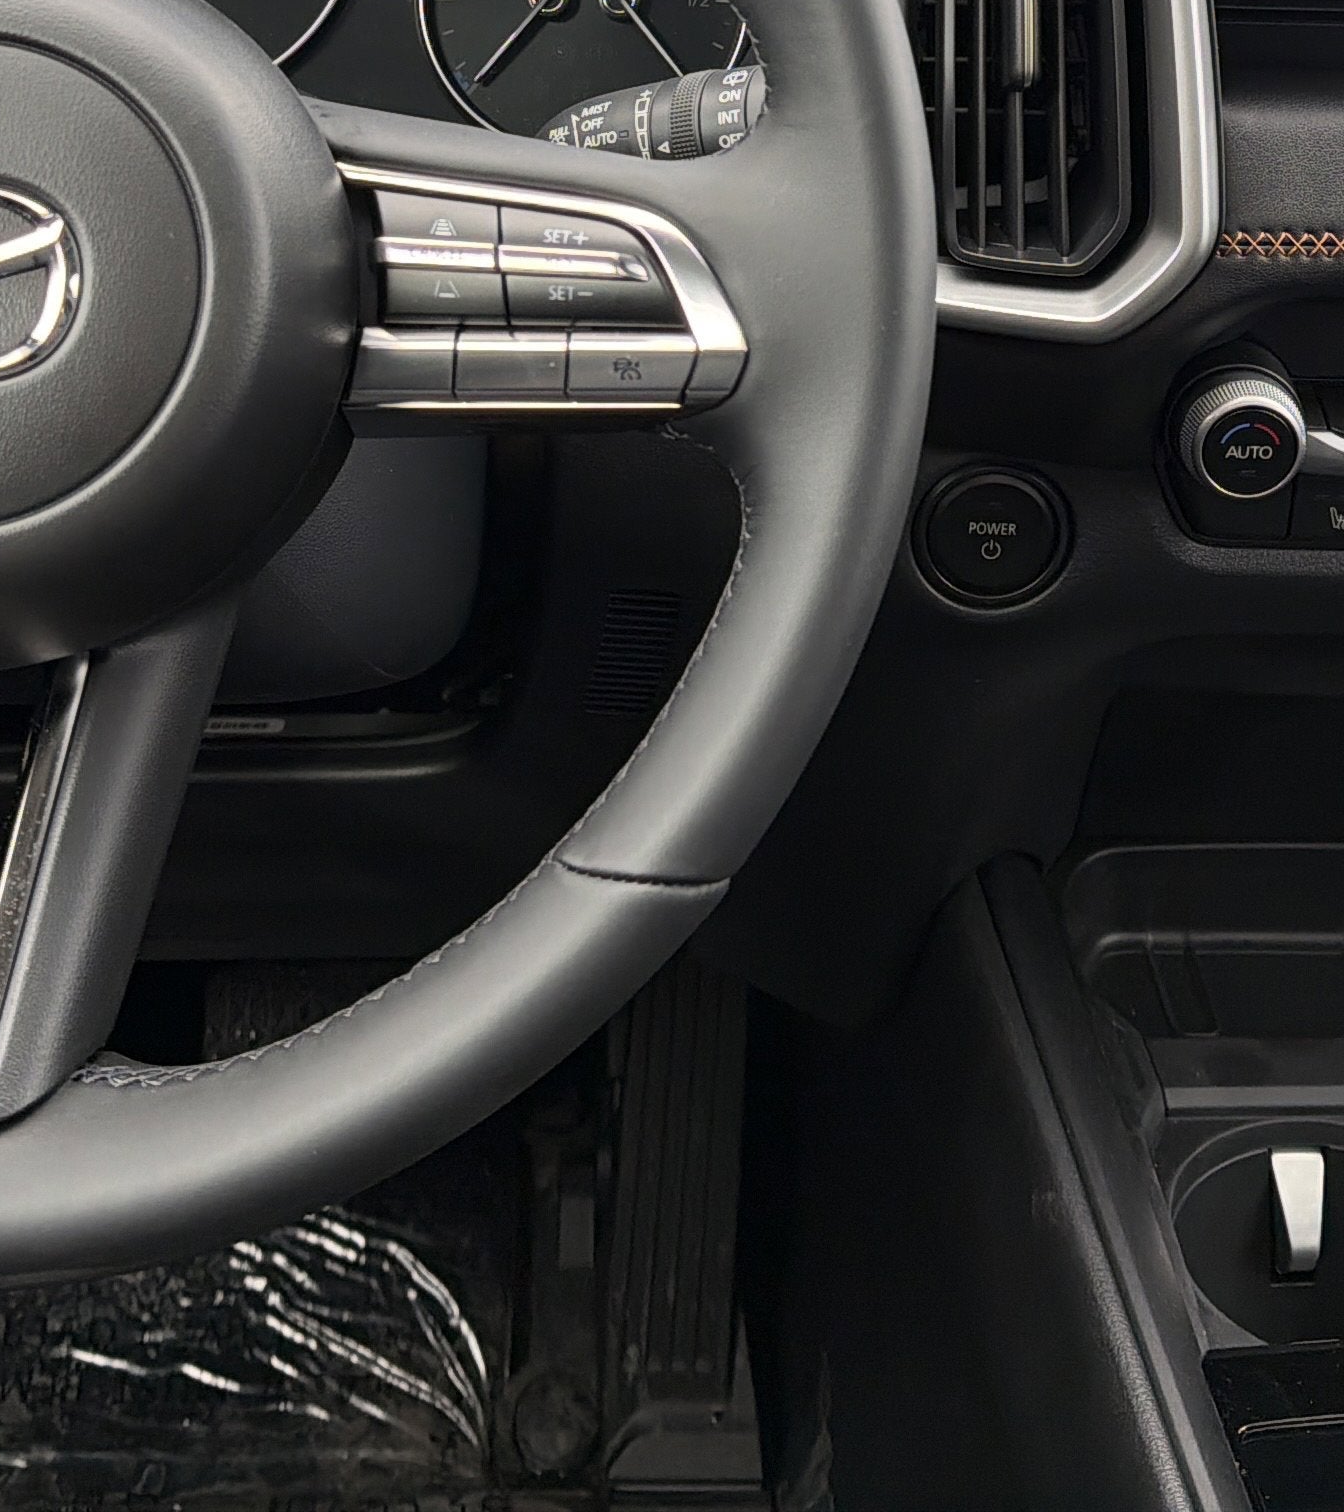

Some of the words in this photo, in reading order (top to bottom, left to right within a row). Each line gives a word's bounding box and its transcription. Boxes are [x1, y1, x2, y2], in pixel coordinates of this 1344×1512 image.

[719, 88, 742, 103] ON
[581, 100, 613, 118] MIST
[718, 108, 741, 125] INT
[581, 116, 605, 132] OFF
[583, 131, 618, 149] AUTO
[1224, 445, 1274, 461] AUTO
[968, 521, 1017, 537] POWER
